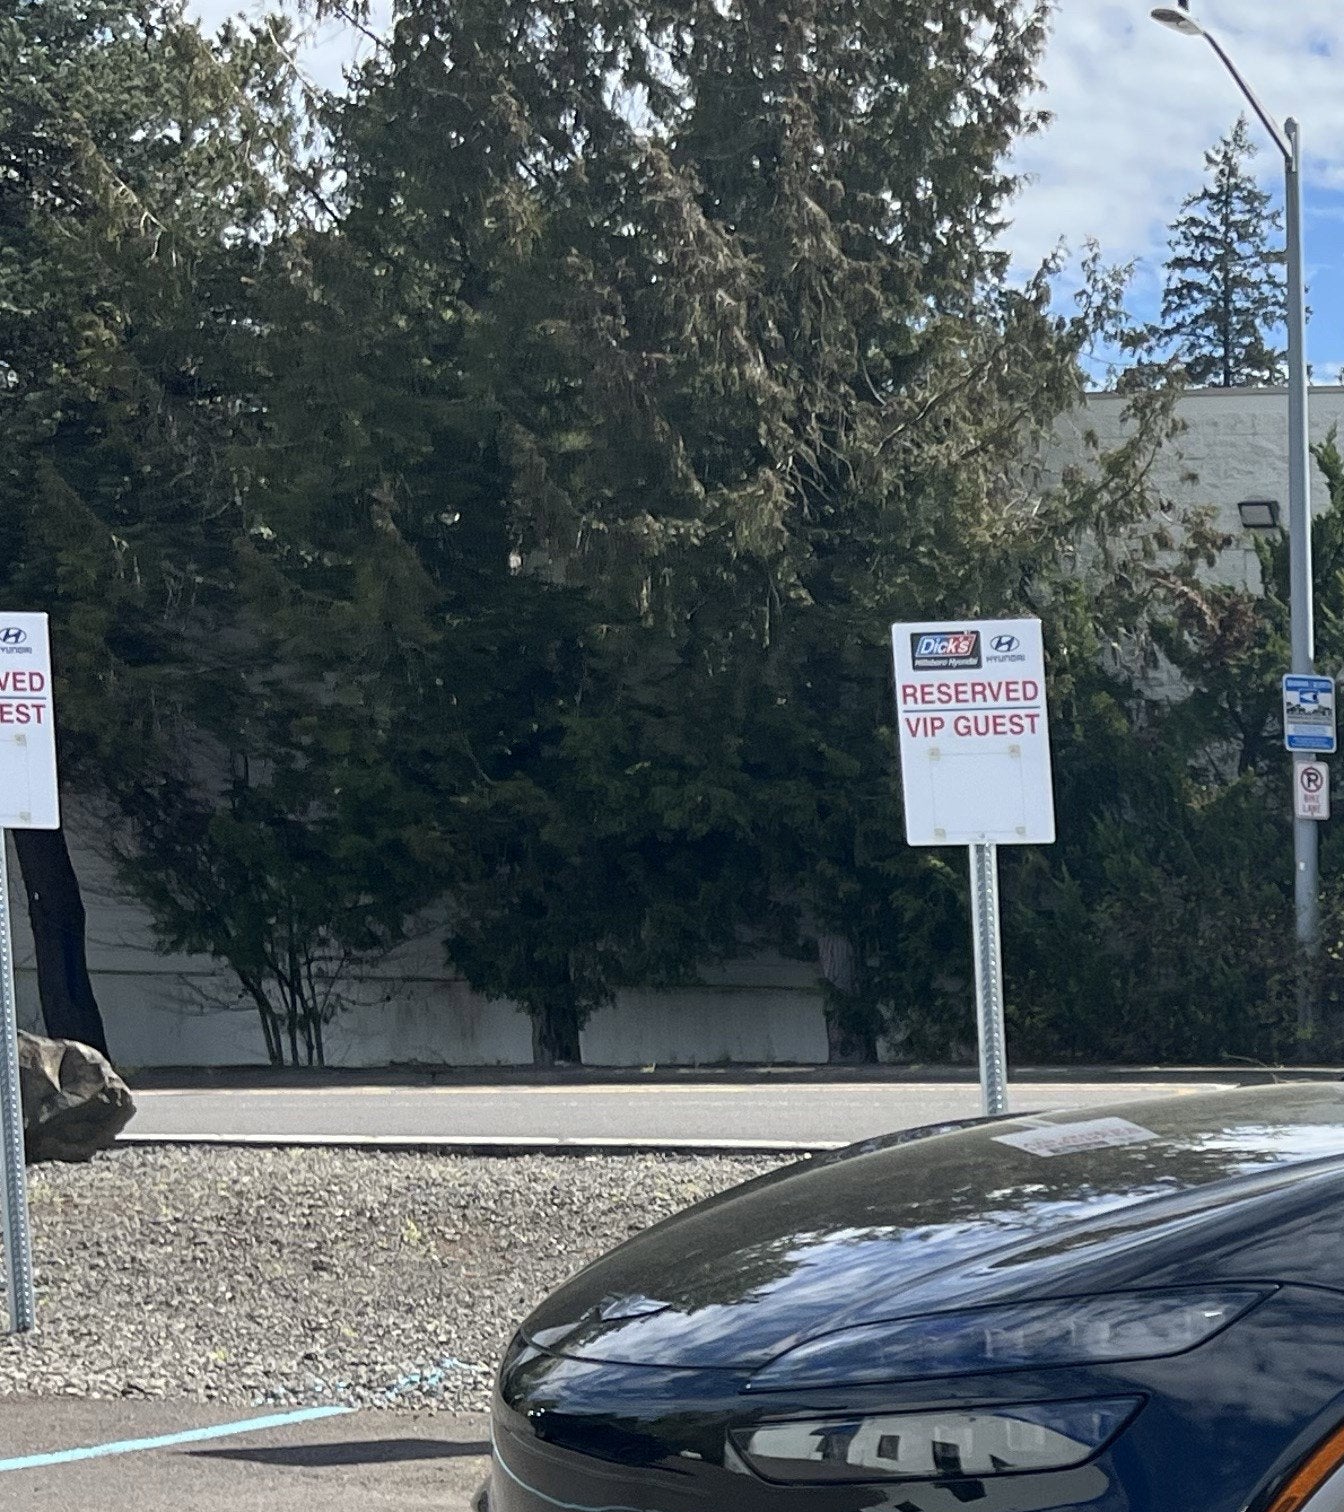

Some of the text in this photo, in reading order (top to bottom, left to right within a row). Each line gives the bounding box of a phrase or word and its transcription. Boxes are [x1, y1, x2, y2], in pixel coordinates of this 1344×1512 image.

[902, 680, 1039, 705] RESERVED
[904, 713, 1040, 738] VIP GUEST
